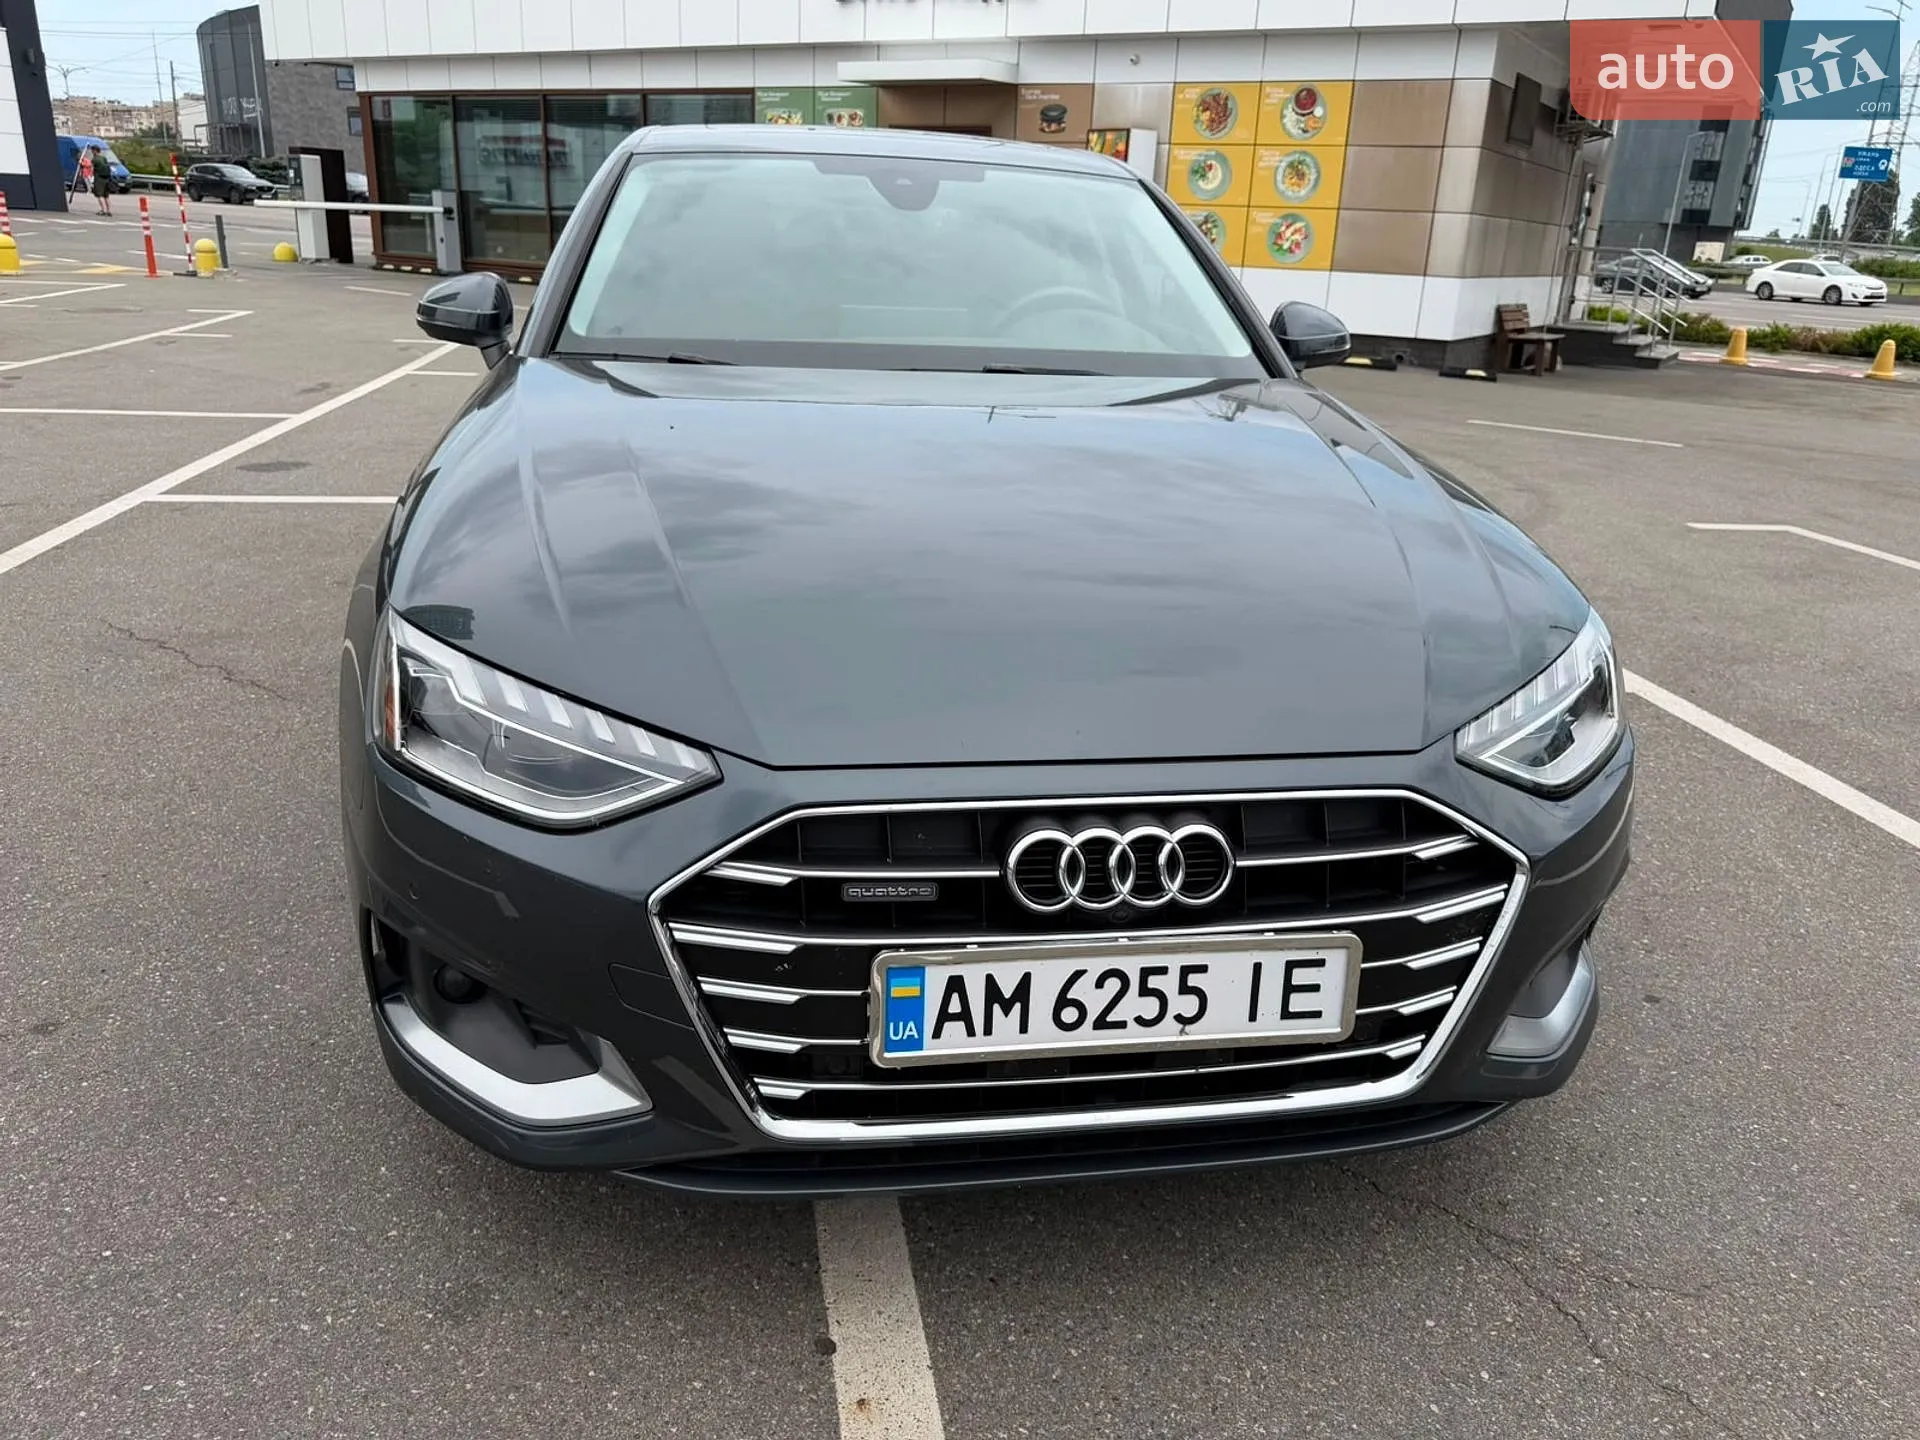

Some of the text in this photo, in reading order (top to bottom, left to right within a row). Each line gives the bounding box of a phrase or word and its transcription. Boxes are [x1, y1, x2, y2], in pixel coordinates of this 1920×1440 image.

[847, 886, 932, 897] quattro
[931, 957, 1327, 1040] AM 6255 IE
[889, 1020, 919, 1041] UA
